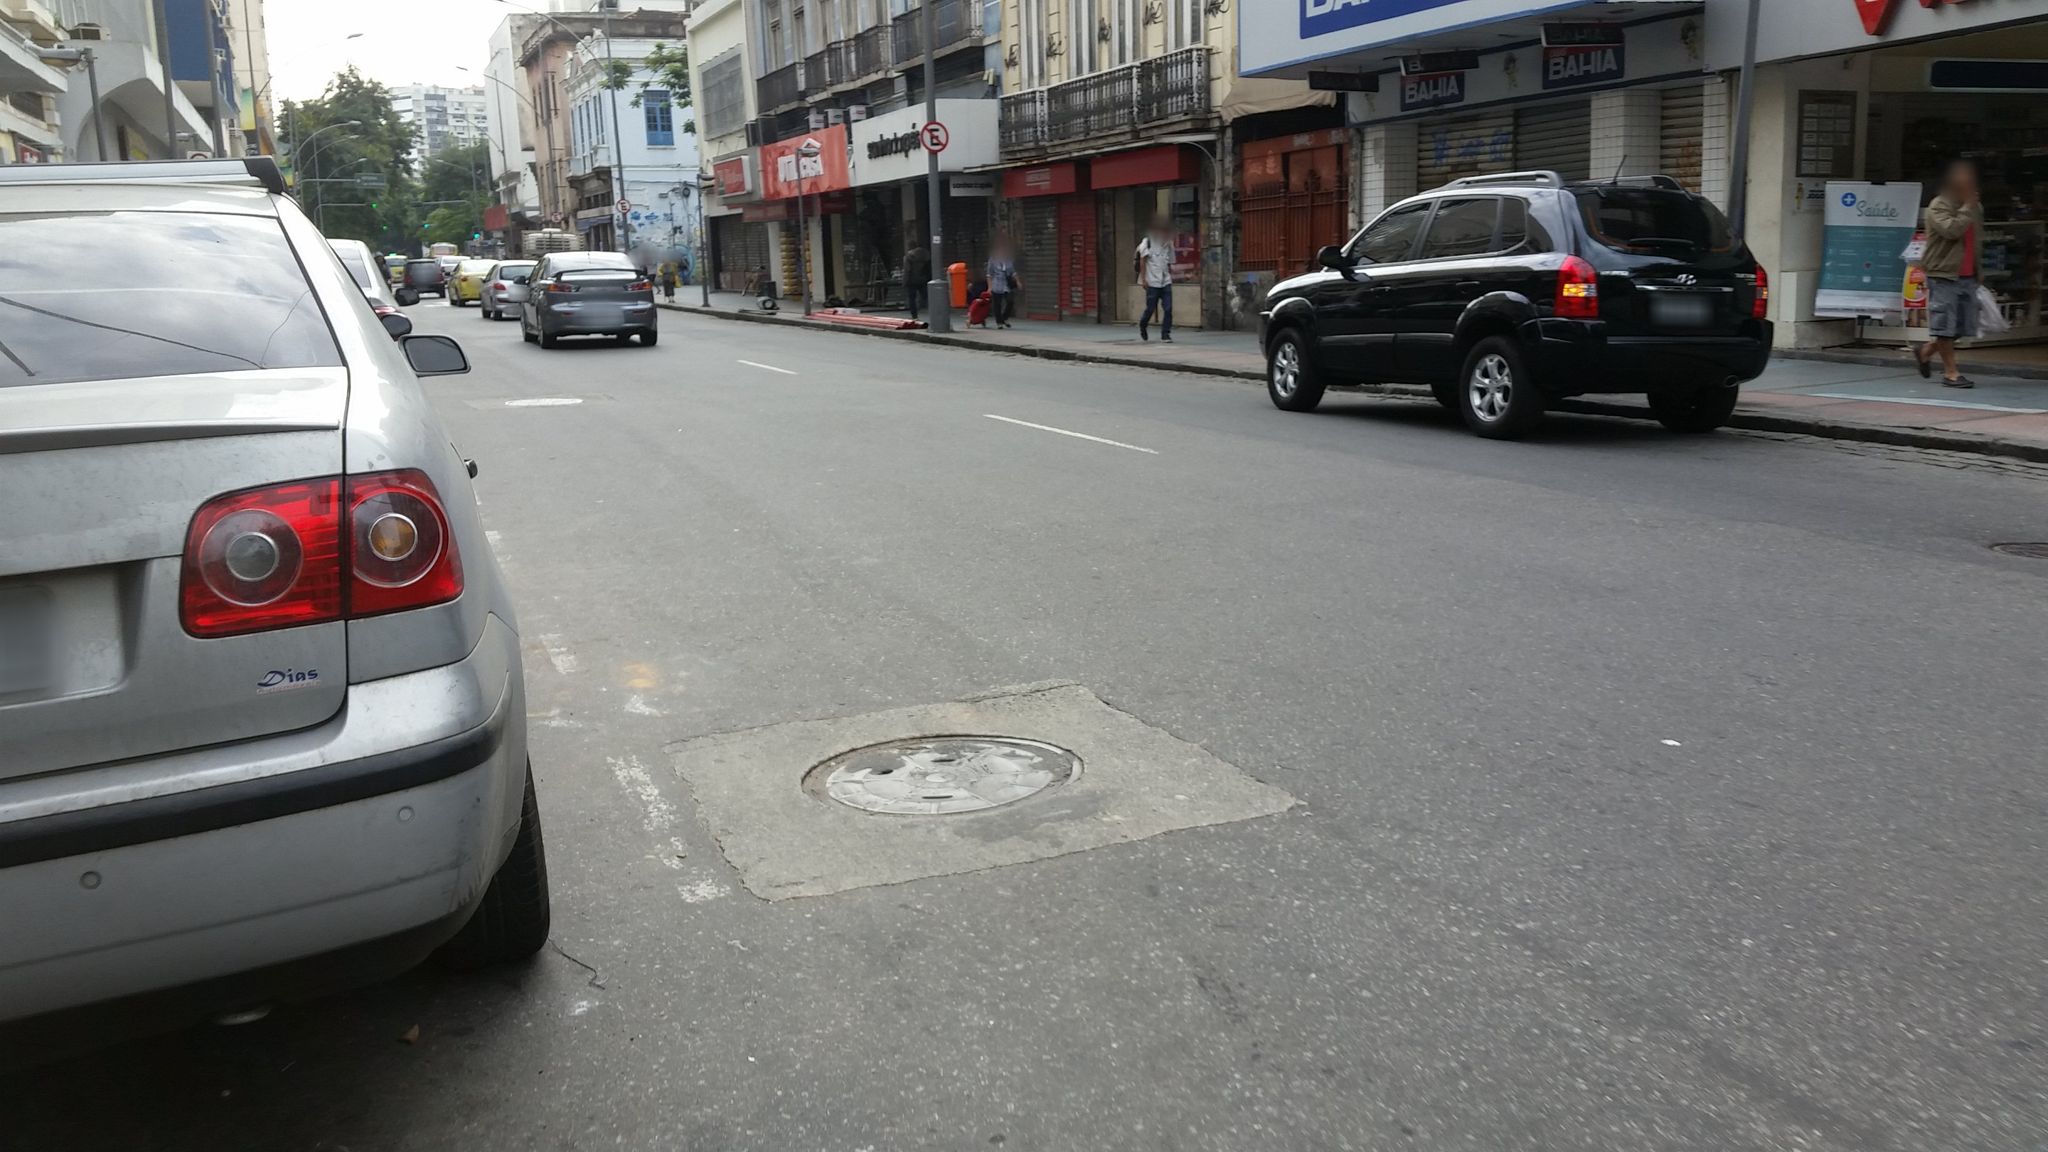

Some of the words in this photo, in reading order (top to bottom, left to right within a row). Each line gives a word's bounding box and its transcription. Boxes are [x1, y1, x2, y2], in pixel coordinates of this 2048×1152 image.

[1548, 48, 1617, 80] BAHIA
[1405, 75, 1459, 104] BAHIA
[930, 128, 940, 146] E
[1856, 200, 1899, 217] Saúde
[257, 668, 319, 687] Dias
